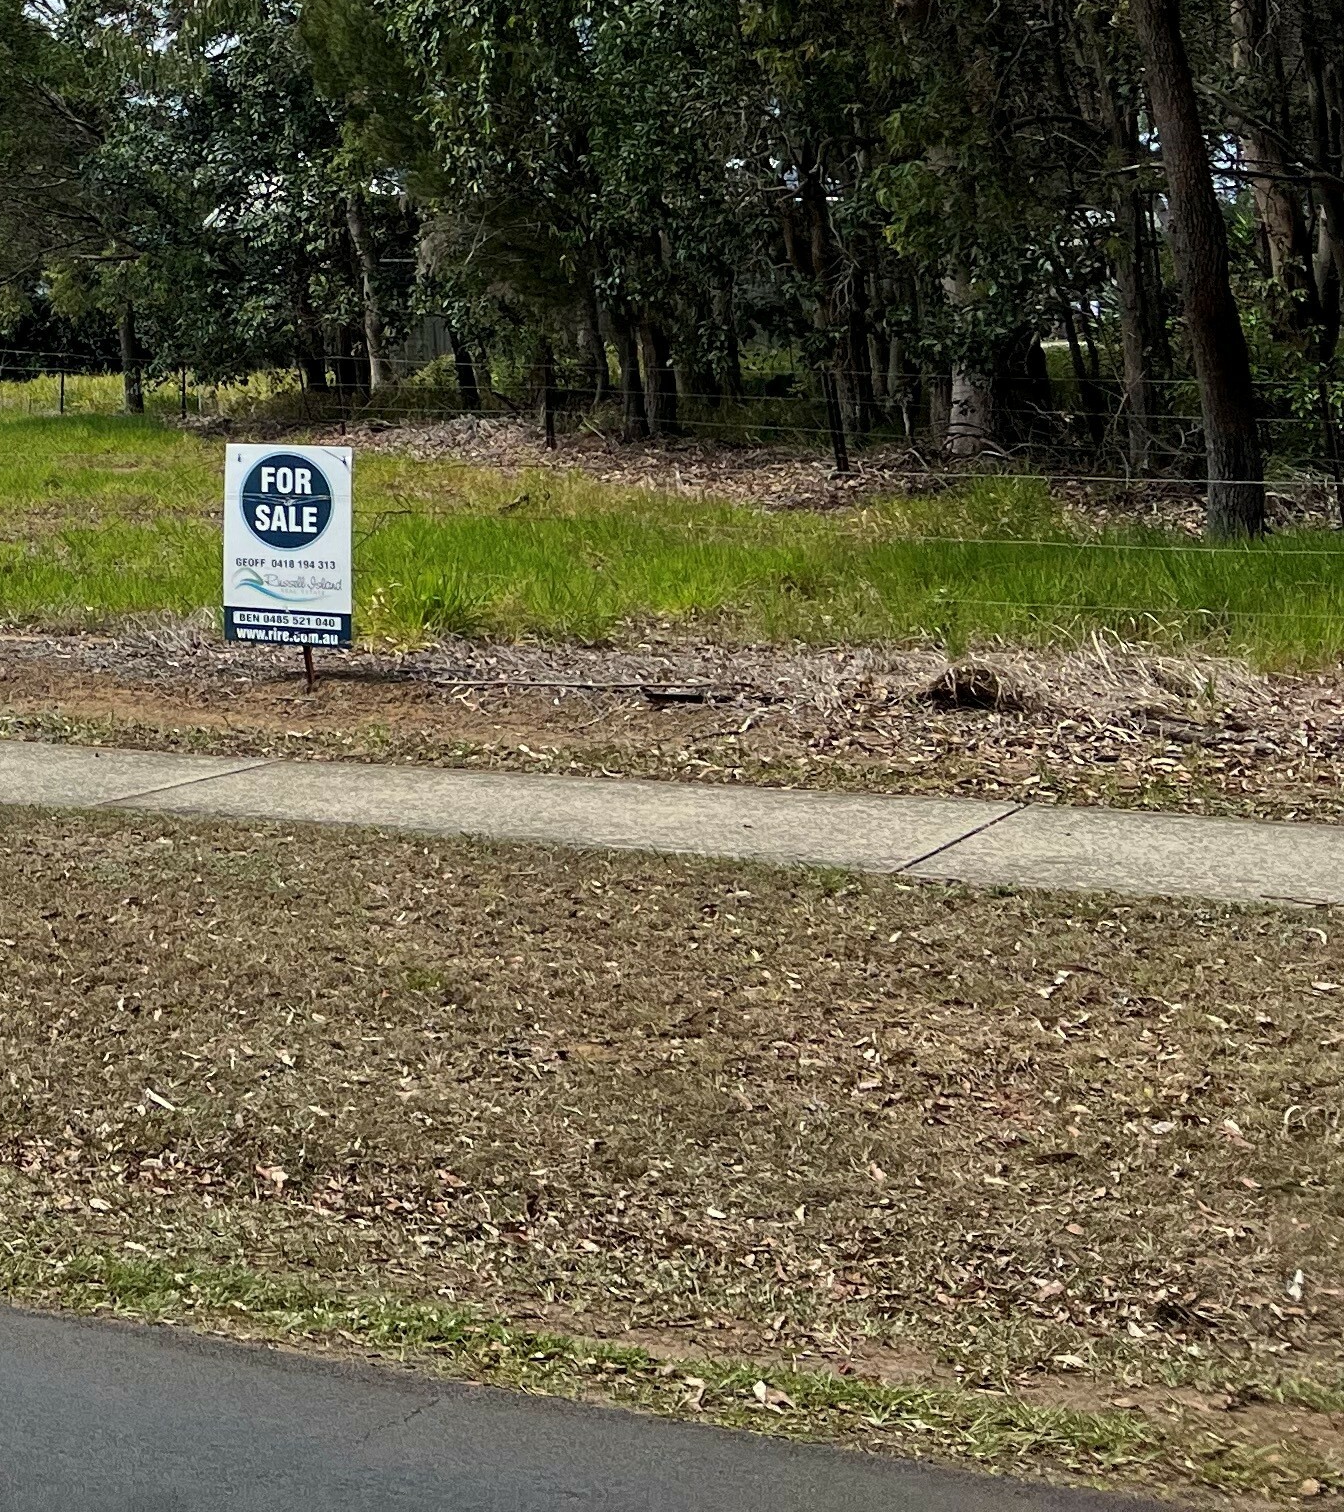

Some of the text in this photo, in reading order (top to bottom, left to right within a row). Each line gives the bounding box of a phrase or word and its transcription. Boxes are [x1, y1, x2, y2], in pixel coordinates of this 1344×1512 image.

[260, 466, 312, 495] FOR
[254, 505, 318, 533] SALE
[235, 557, 336, 570] GEOFF 0418 194 313
[239, 613, 335, 627] BEN 0485 521 040
[236, 627, 339, 645] www.rire.com.au
